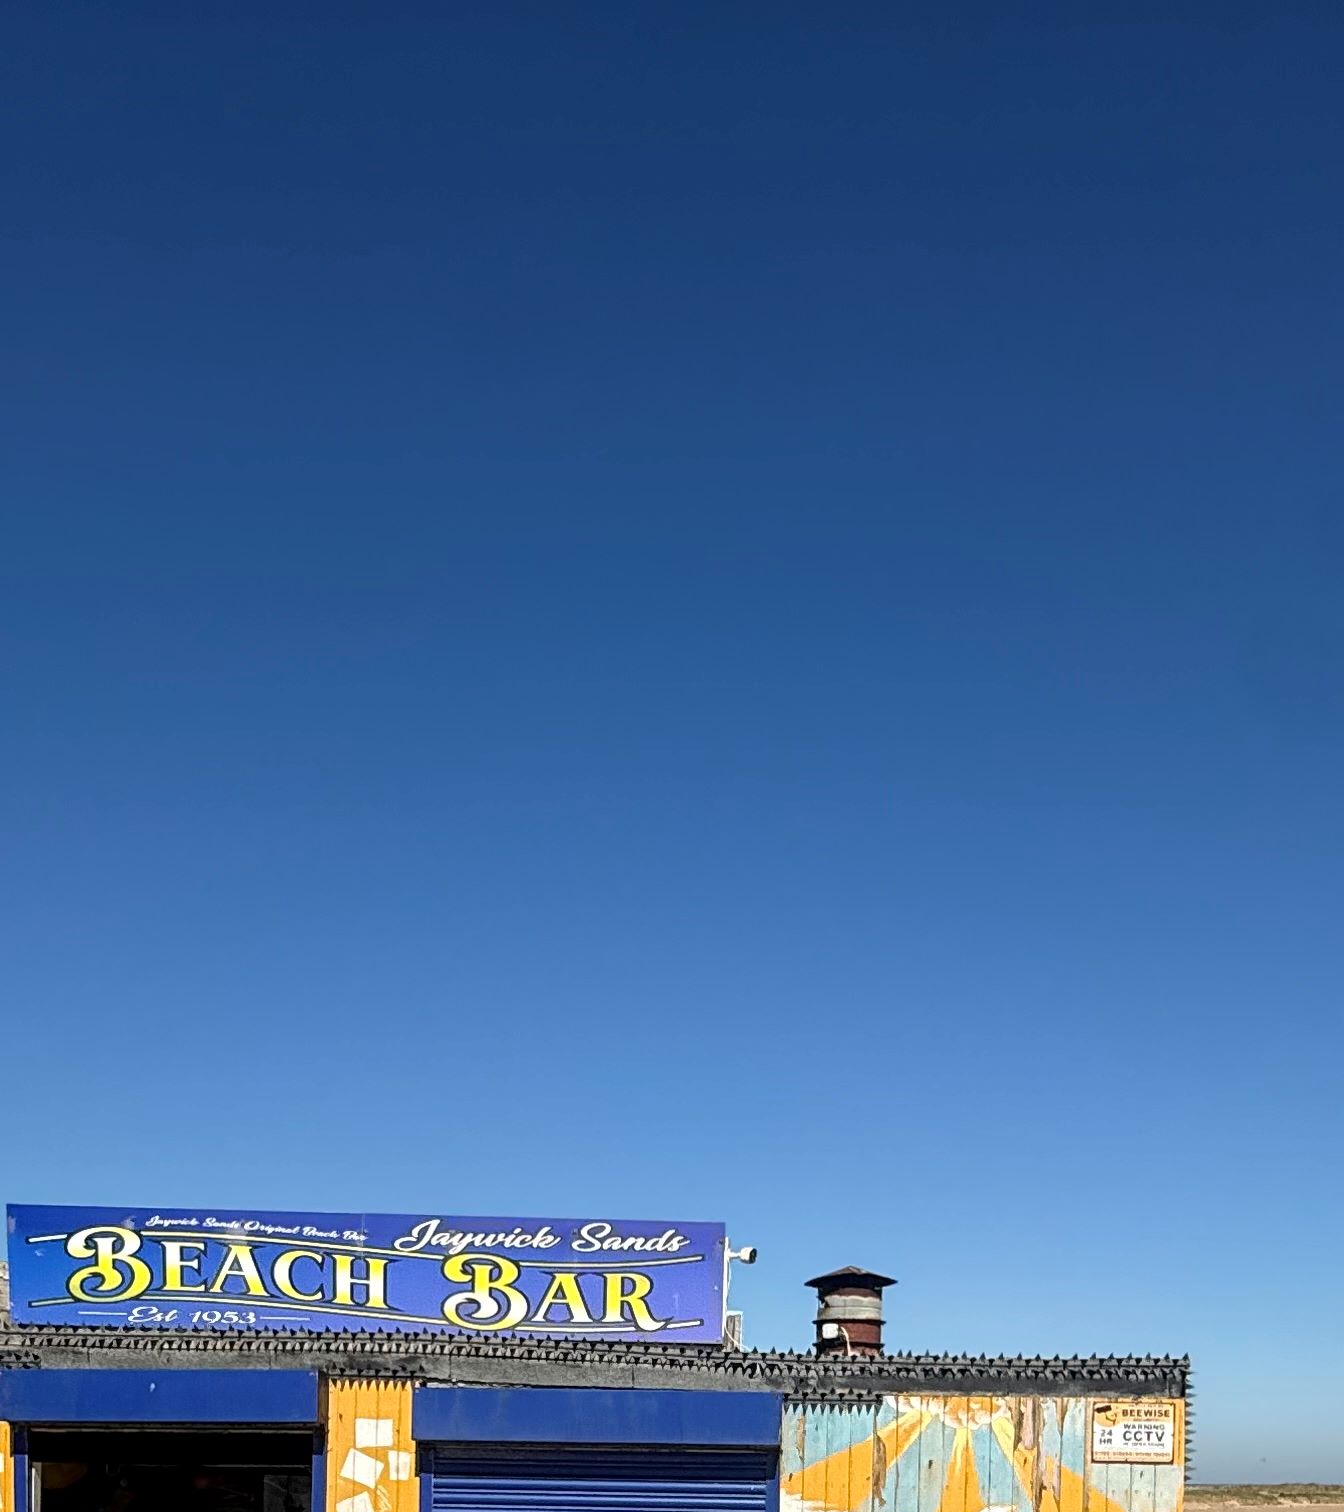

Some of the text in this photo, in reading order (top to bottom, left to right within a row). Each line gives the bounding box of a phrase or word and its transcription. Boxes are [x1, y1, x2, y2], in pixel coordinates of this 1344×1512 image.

[203, 1217, 240, 1229] Sands
[243, 1220, 298, 1235] Original
[393, 1219, 691, 1254] Jaywick Sands
[67, 1226, 676, 1331] BEACH BAR
[127, 1306, 256, 1324] Est 1953
[1121, 1409, 1170, 1418] BEEWISE
[1123, 1430, 1165, 1442] CCTV
